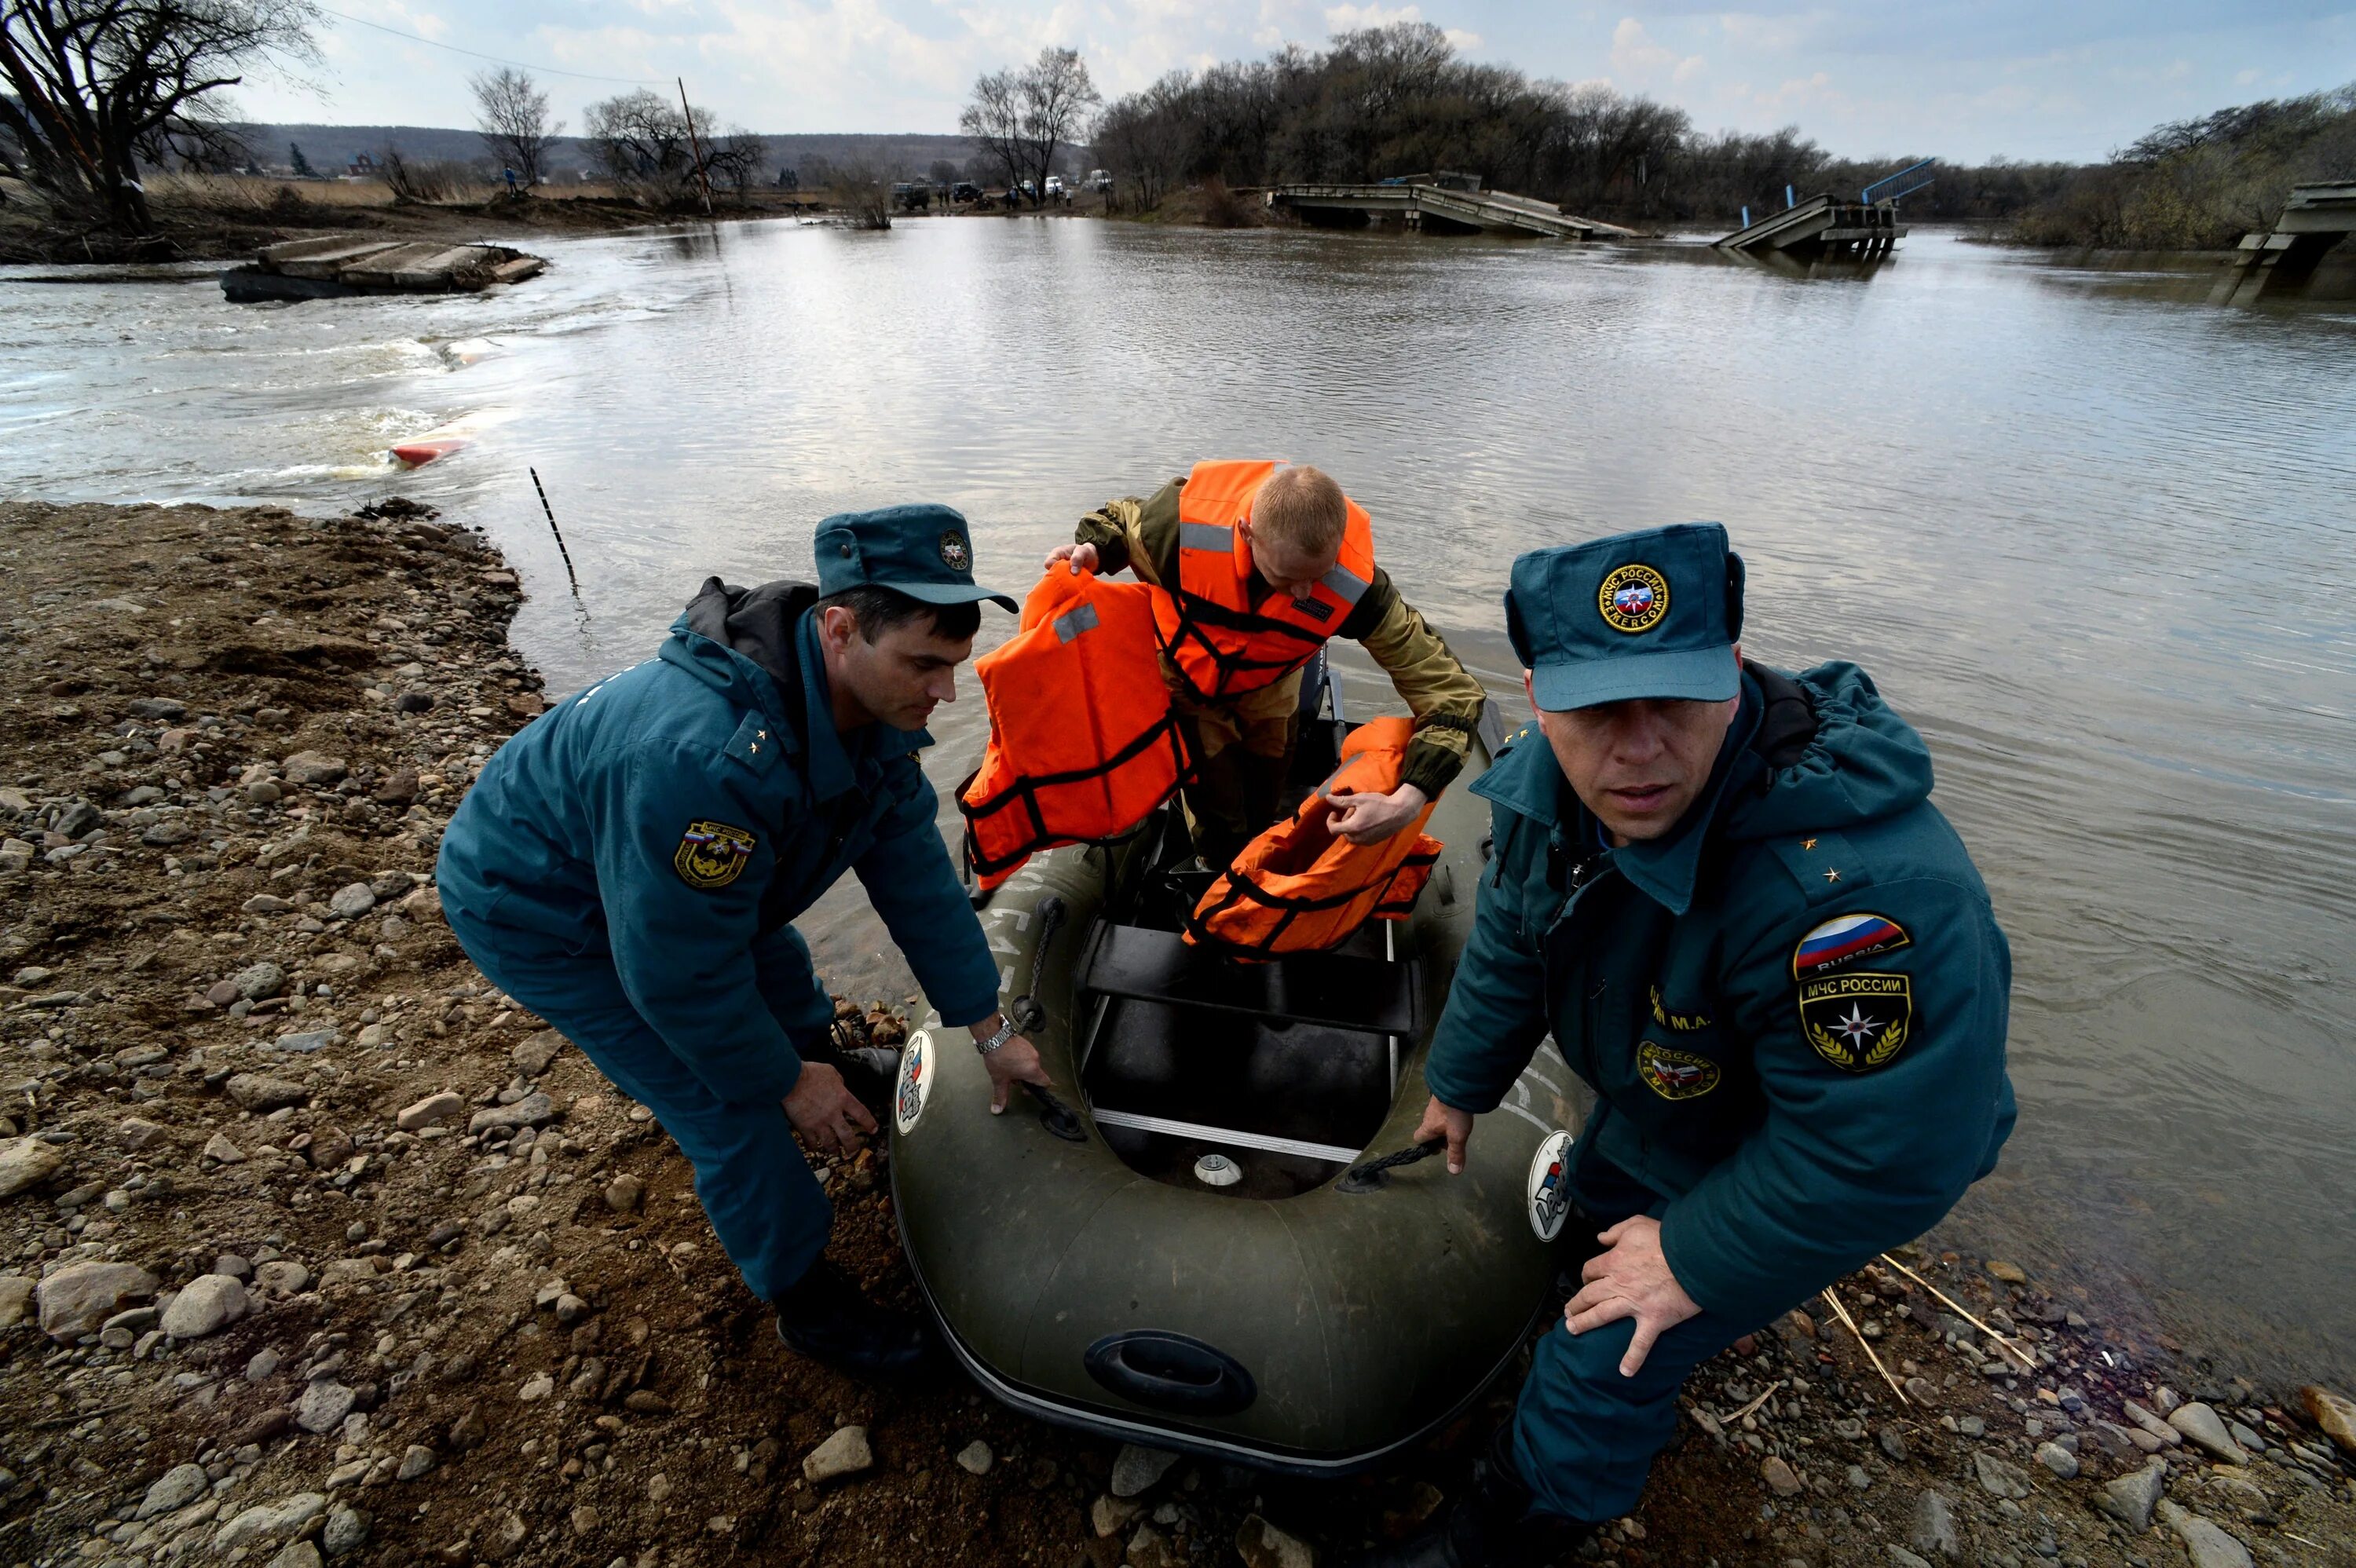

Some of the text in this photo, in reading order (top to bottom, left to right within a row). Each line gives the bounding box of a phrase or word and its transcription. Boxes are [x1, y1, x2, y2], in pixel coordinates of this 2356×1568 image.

[1602, 569, 1663, 600] МЧС РОССИИ
[1604, 601, 1663, 627] EMERCOM
[1816, 942, 1885, 972] RUSSIA
[1808, 978, 1901, 998] МЧС РОССИИ
[1670, 1015, 1712, 1031] М.А.
[902, 1035, 920, 1123] Leader
